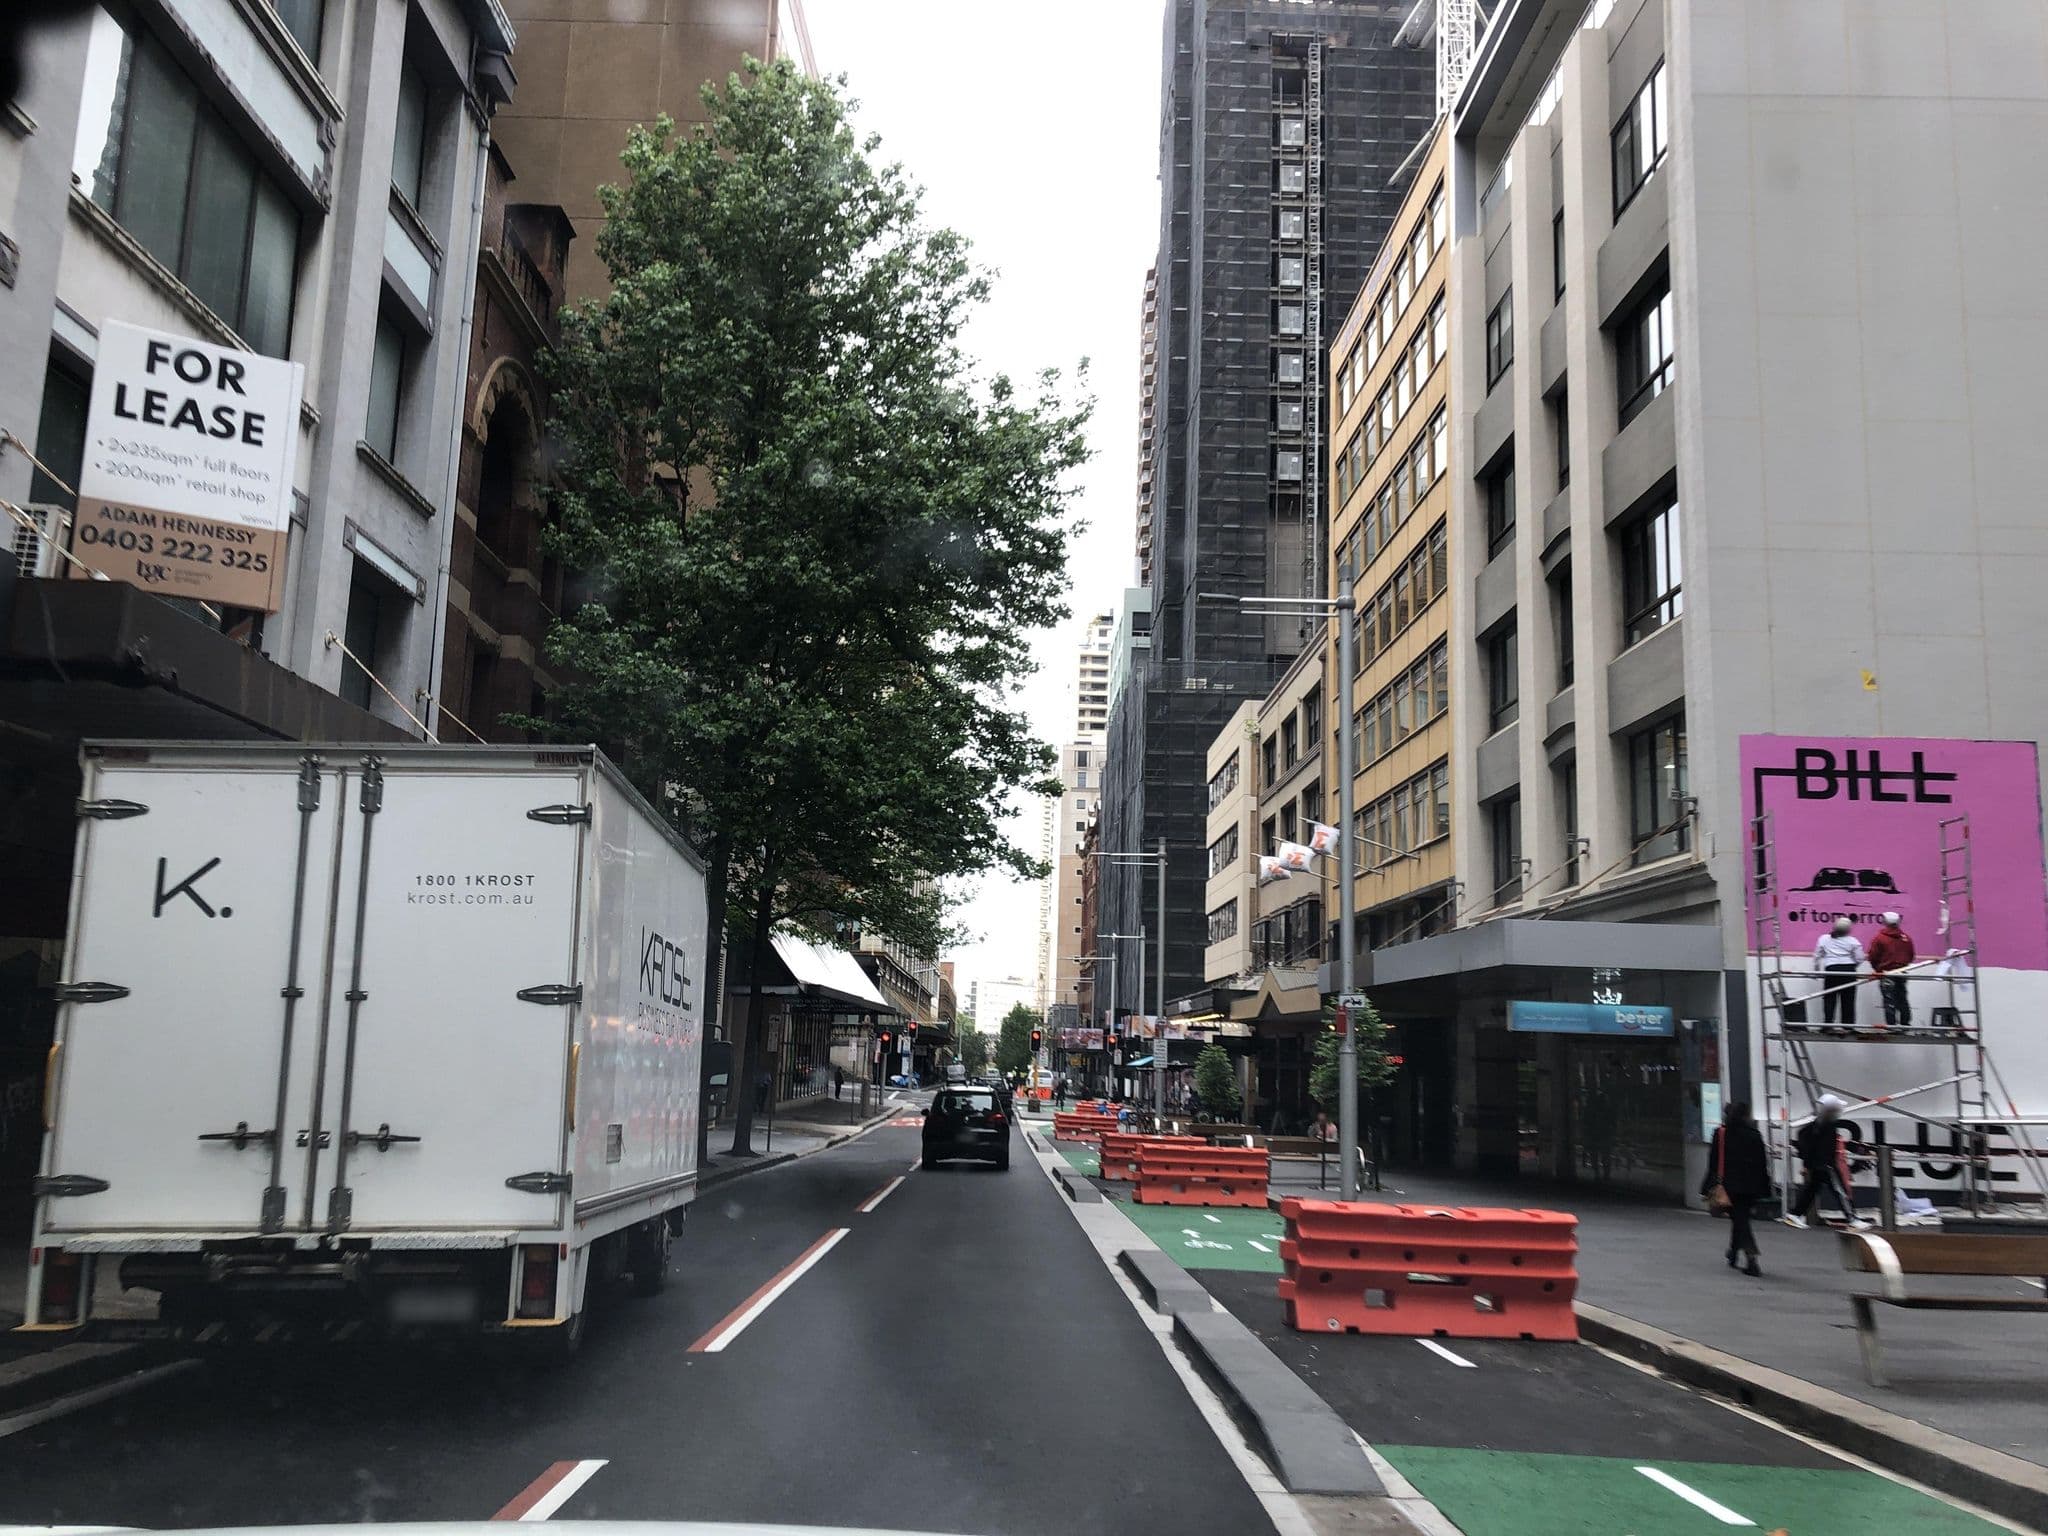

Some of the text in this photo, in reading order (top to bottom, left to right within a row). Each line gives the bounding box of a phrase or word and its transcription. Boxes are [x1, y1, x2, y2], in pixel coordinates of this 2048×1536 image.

[146, 339, 246, 396] FOR
[114, 382, 266, 447] LEASE
[204, 456, 227, 474] full
[229, 462, 271, 483] floors
[186, 478, 227, 497] retail
[230, 484, 266, 505] shop
[99, 506, 158, 528] ADAM
[162, 516, 258, 545] HENNESSY
[80, 524, 268, 573] 0403 222 325
[1796, 748, 1957, 803] BILL
[153, 857, 232, 918] K.
[407, 892, 534, 905] krost.com.au
[416, 875, 535, 886] 1800 1KROST
[1788, 908, 1904, 925] of tomorro
